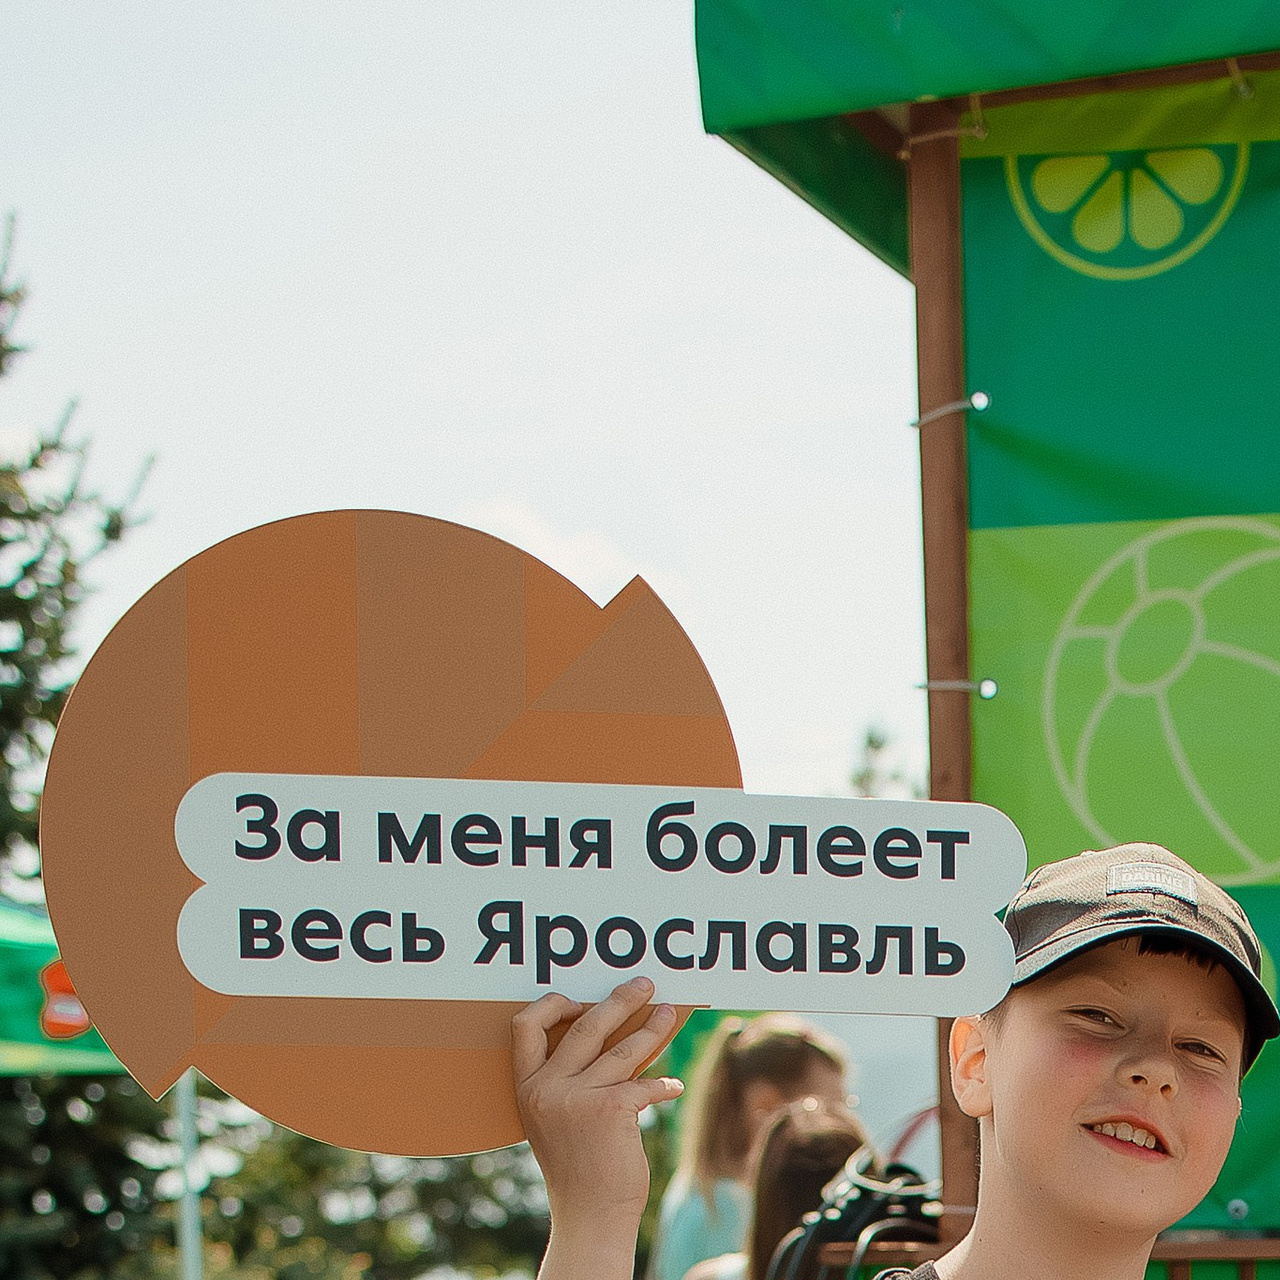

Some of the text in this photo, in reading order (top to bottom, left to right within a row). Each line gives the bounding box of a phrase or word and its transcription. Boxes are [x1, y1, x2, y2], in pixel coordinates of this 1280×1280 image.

[234, 793, 973, 881] За меня болеет
[238, 899, 967, 986] весь Ярославль
